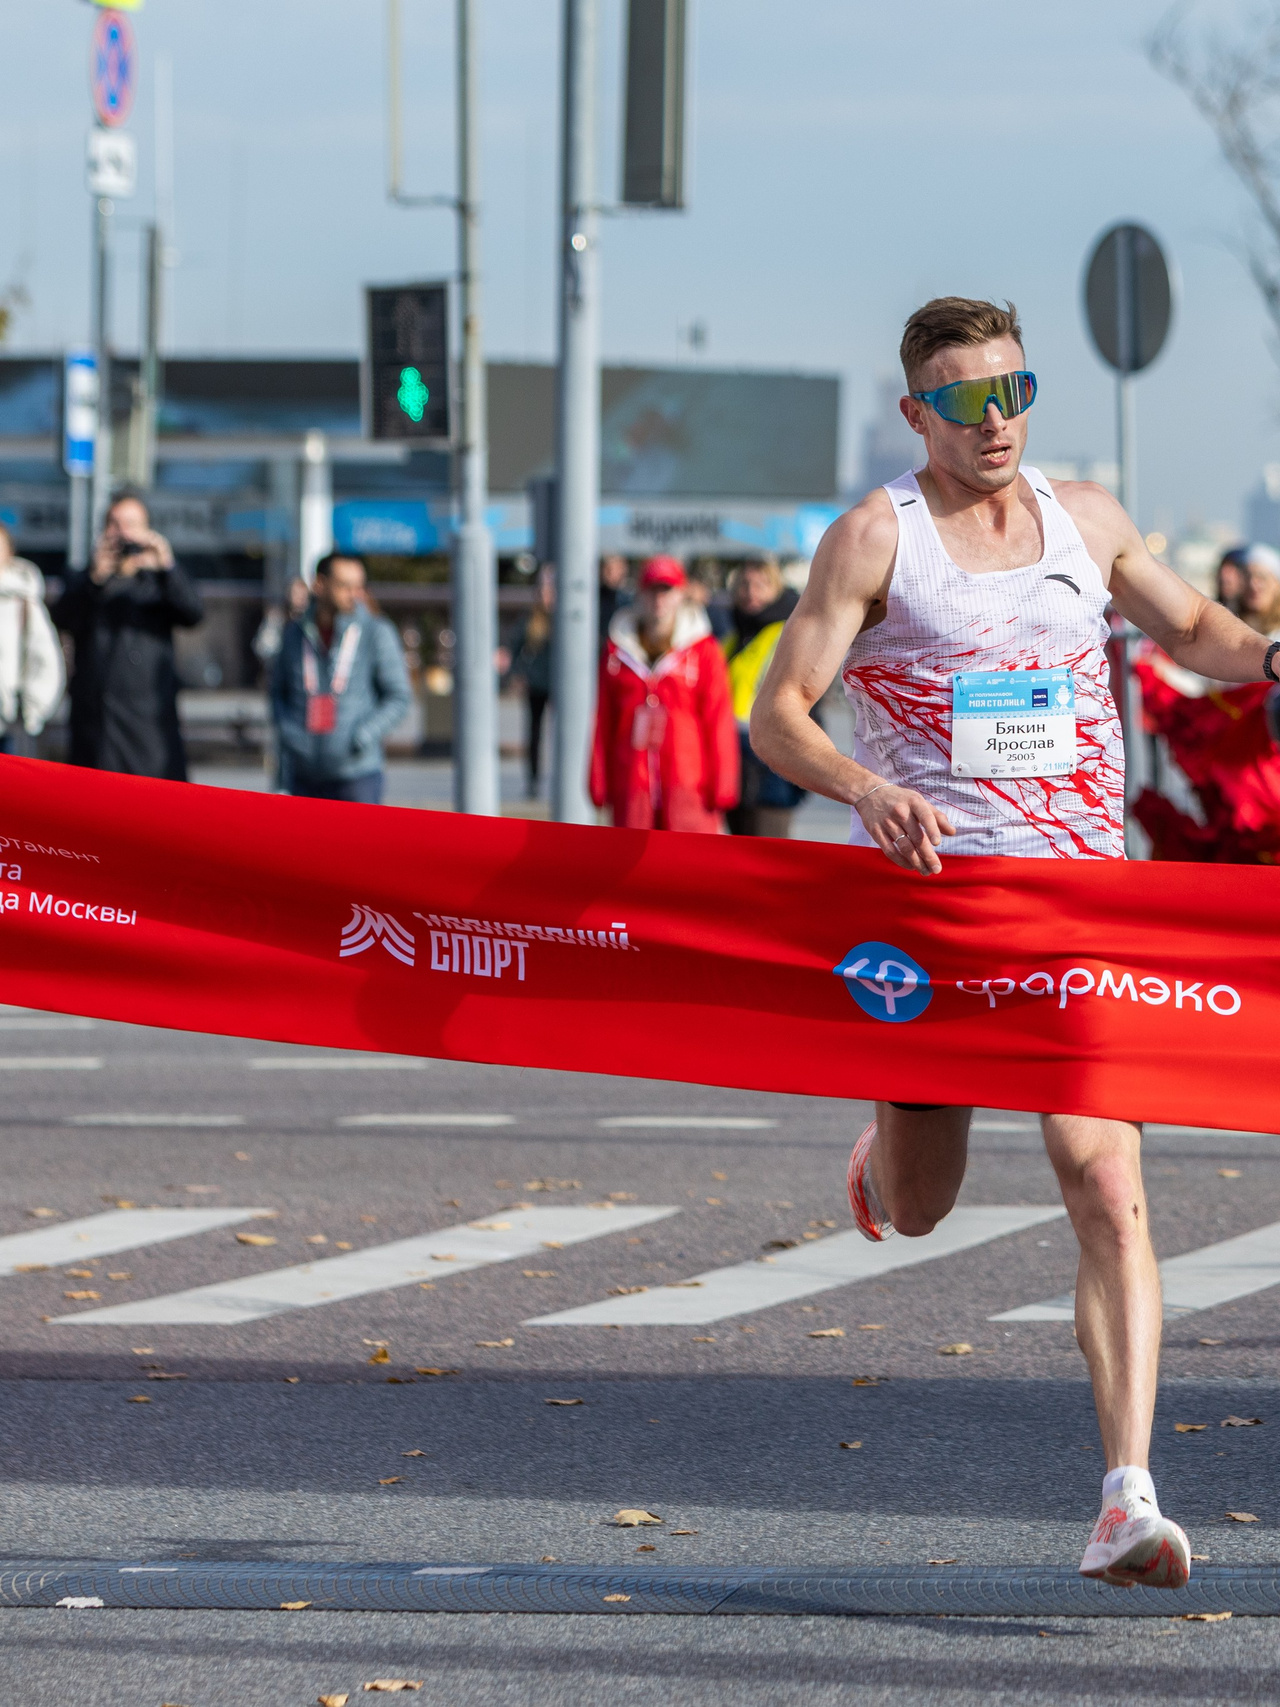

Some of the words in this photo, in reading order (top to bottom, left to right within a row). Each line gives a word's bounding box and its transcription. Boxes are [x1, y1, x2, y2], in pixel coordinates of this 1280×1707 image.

[987, 698, 1025, 707] СТОЛИЦА
[996, 722, 1045, 734] Бякин
[985, 738, 1054, 753] Ярослав
[1006, 753, 1035, 761] 25003
[29, 892, 136, 925] Москвы
[430, 930, 529, 981] СПОРТ
